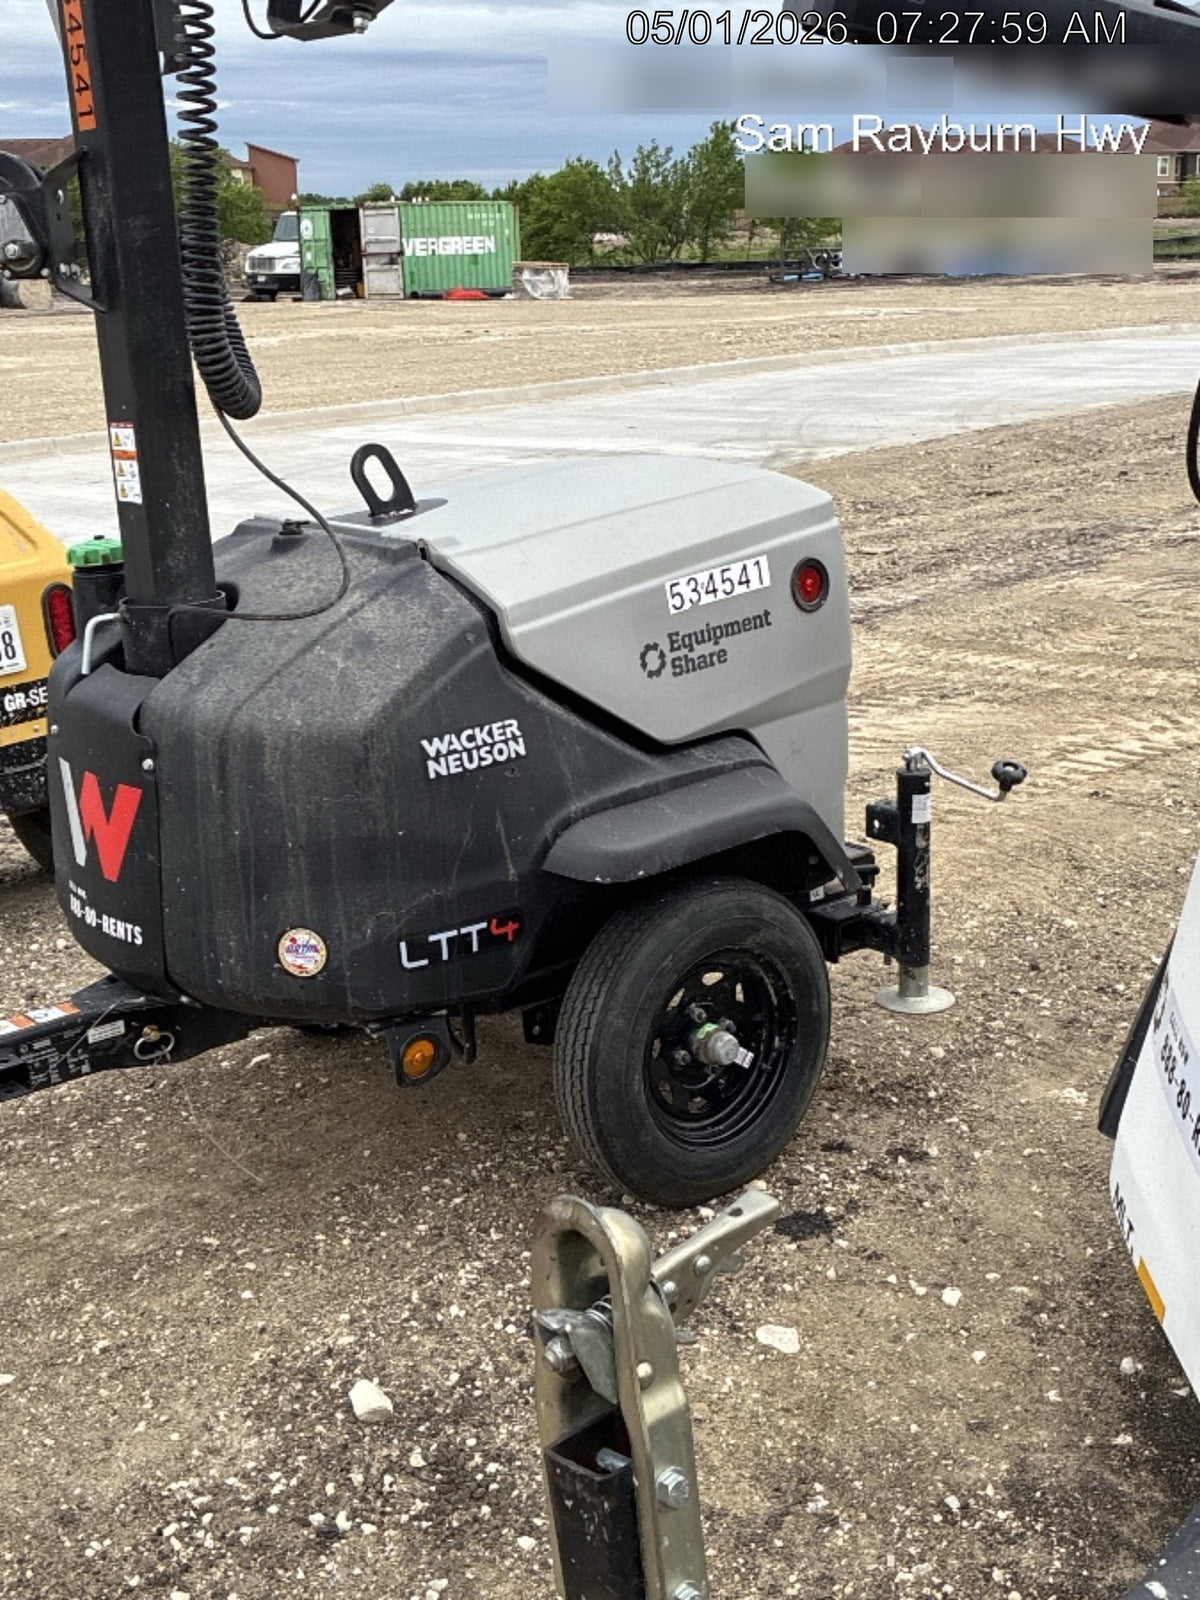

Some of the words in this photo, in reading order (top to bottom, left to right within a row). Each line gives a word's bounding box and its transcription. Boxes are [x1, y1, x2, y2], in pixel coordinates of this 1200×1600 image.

[64, 0, 93, 117] 4541
[669, 559, 764, 611] 534541
[667, 609, 772, 653] Equipment
[671, 648, 728, 677] Share
[420, 718, 522, 758] WACKER
[426, 737, 527, 779] NEUSON
[400, 918, 519, 969] LTT4
